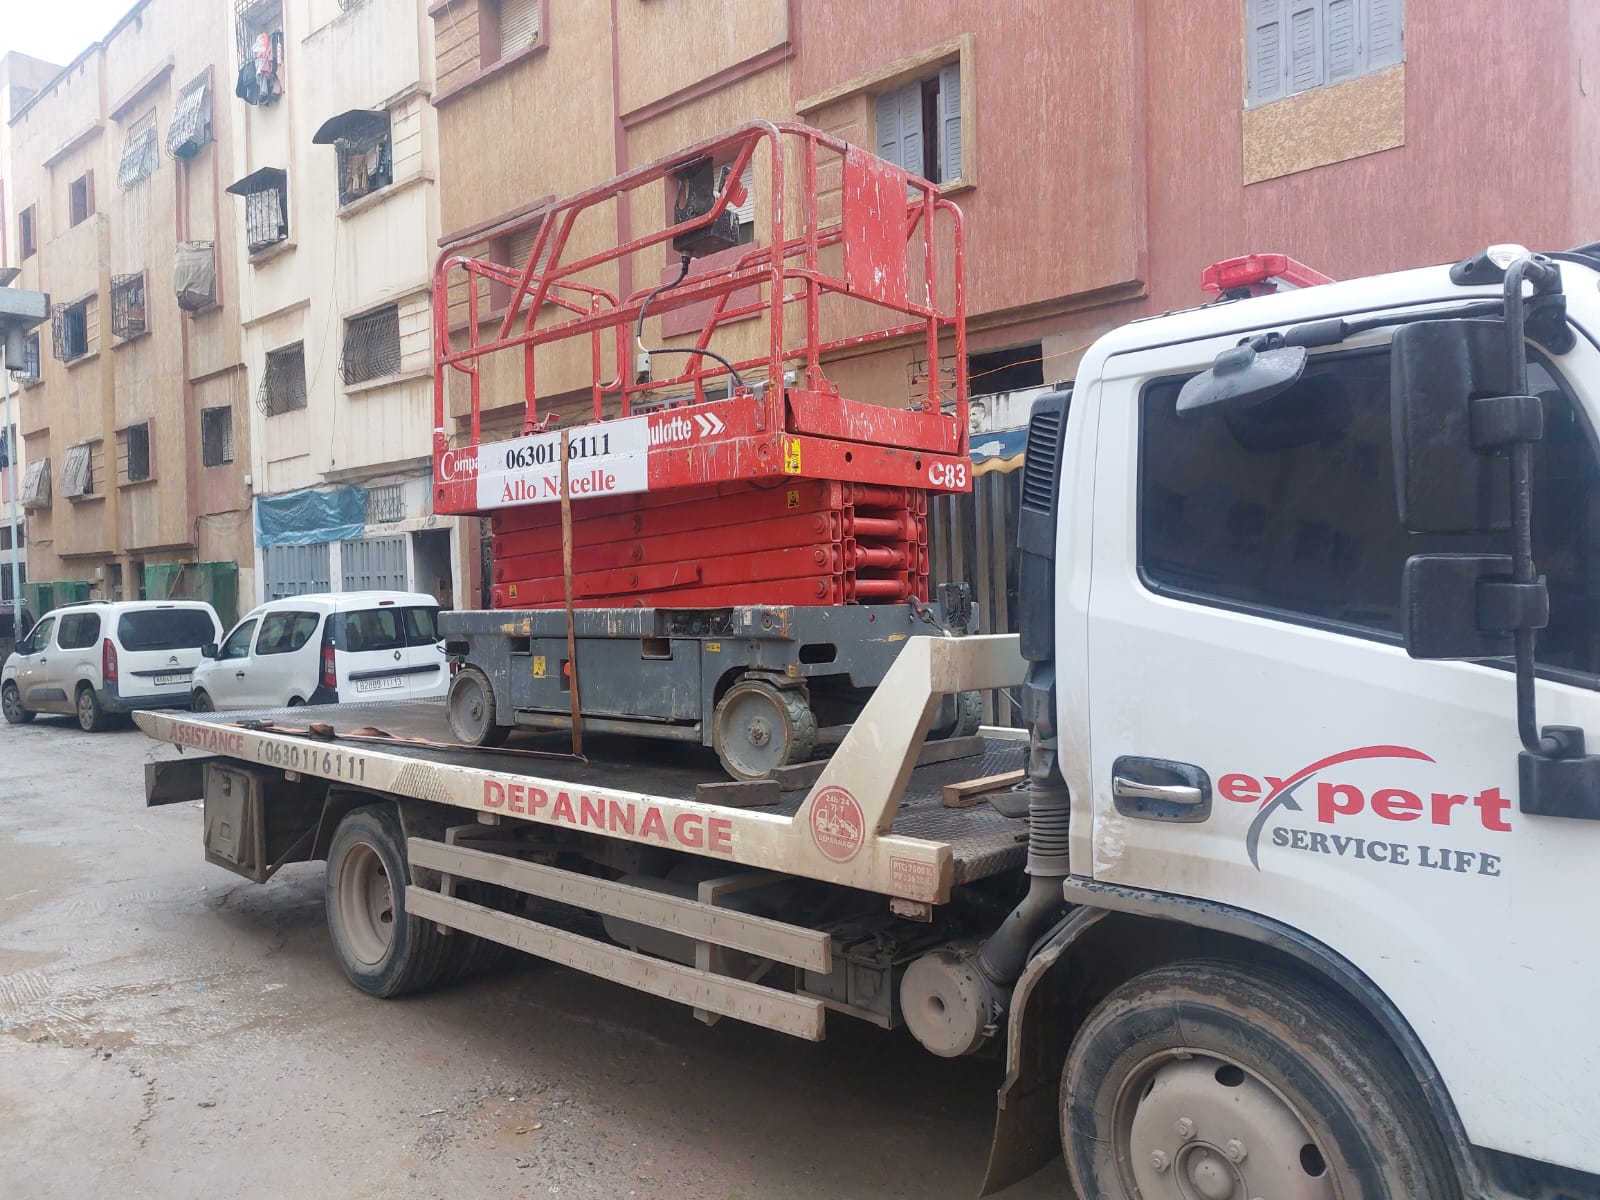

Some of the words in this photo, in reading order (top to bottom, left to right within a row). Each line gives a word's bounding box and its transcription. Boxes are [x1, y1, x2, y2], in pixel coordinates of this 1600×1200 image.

[506, 433, 611, 470] 063016111
[501, 480, 537, 502] Allo
[542, 470, 616, 498] Ncelle
[928, 461, 966, 488] C83
[170, 722, 244, 756] ASSISTANCE
[483, 779, 733, 854] DEPANNAGE
[1217, 770, 1512, 832] expert
[1272, 826, 1410, 866] SERVICE
[1417, 845, 1501, 877] LIFE
